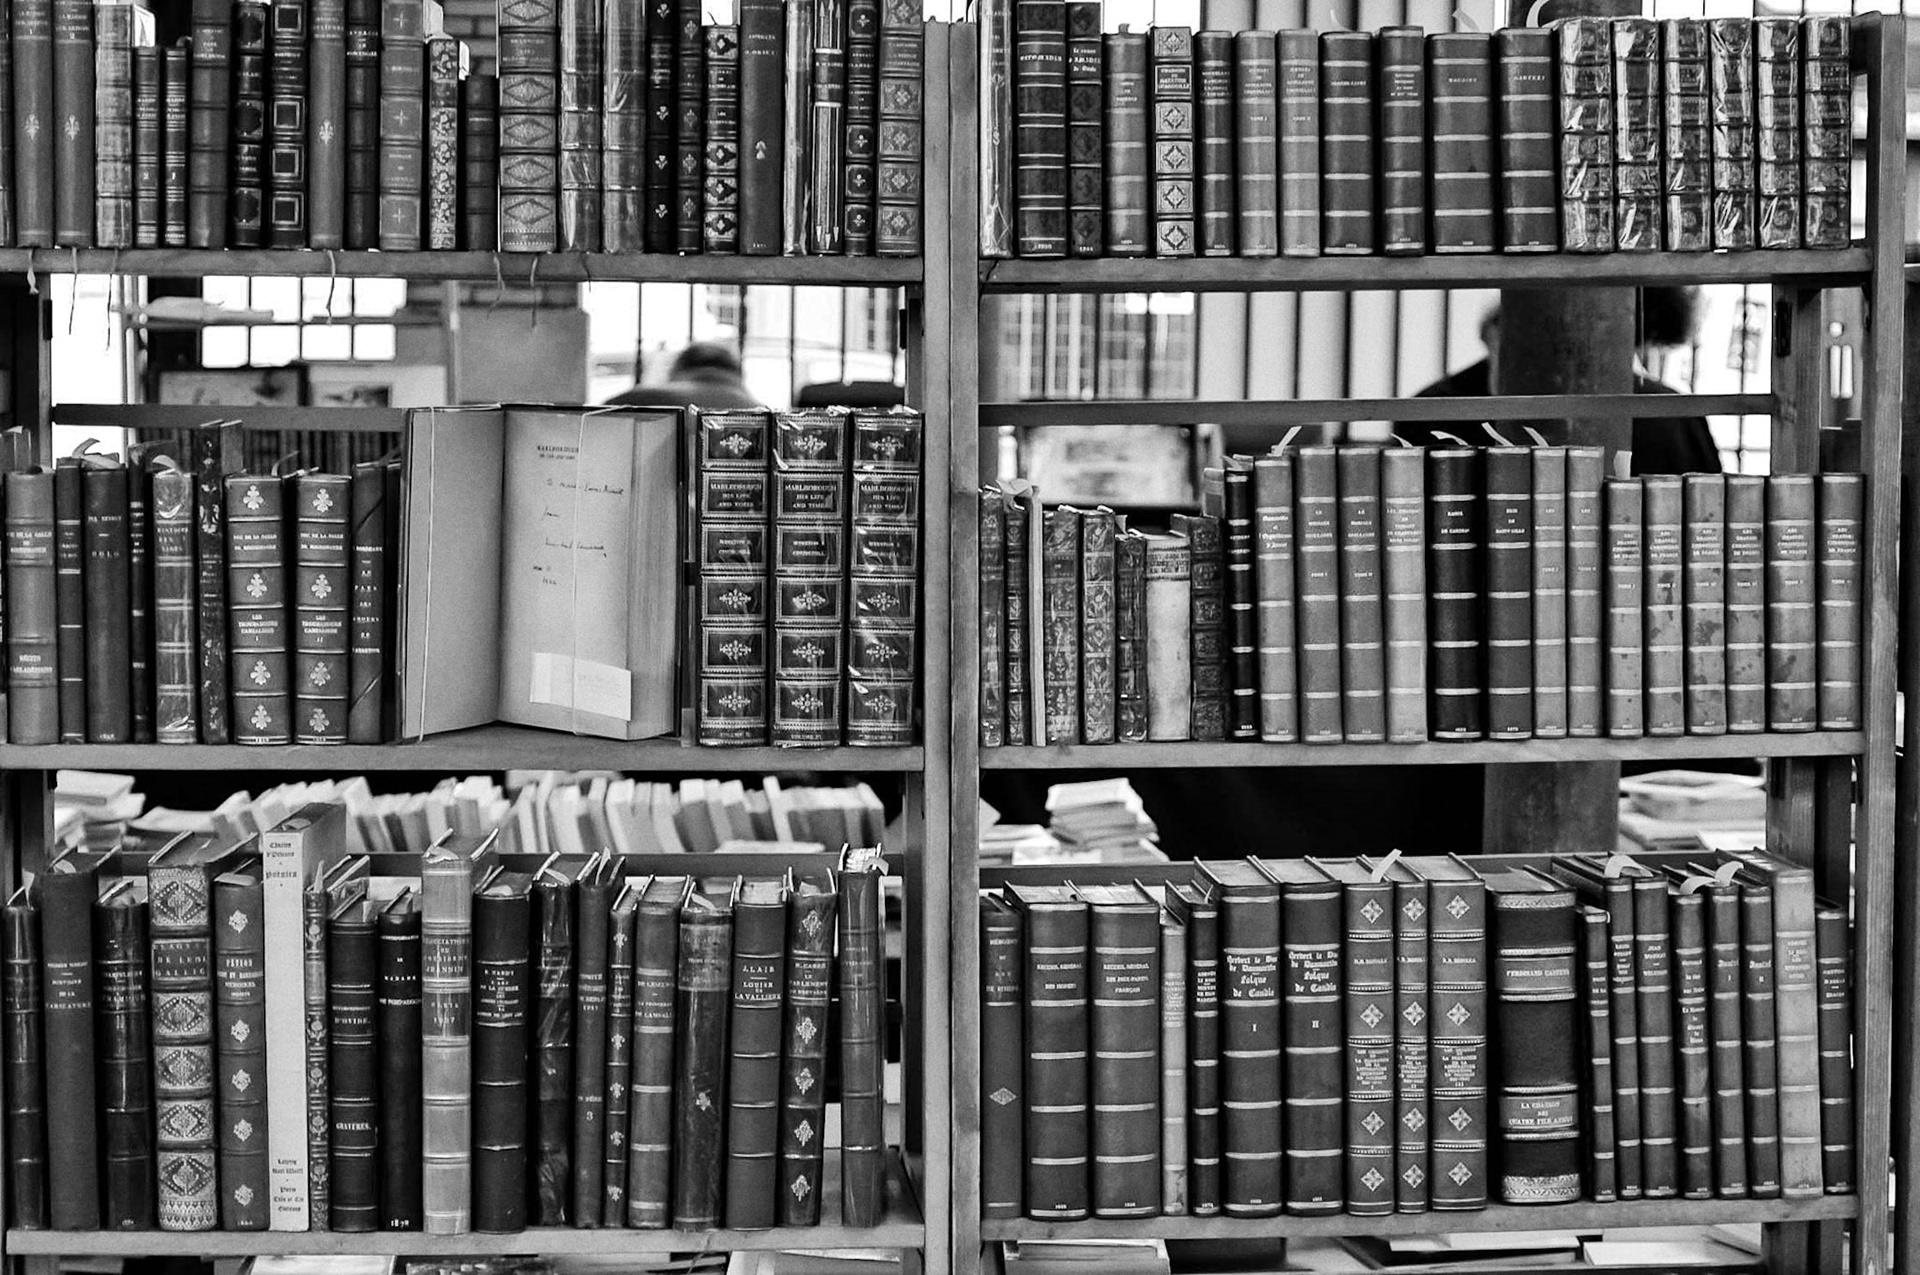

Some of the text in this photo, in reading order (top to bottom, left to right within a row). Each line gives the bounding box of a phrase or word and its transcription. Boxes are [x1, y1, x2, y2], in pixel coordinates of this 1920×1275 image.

[861, 485, 912, 493] MARLBOROUGH
[1316, 951, 1322, 960] le
[1229, 963, 1277, 972] de Dammartin
[1290, 959, 1338, 968] de Dammartin
[1240, 975, 1267, 986] Folque
[1303, 971, 1330, 982] Folque
[1311, 1020, 1320, 1029] II
